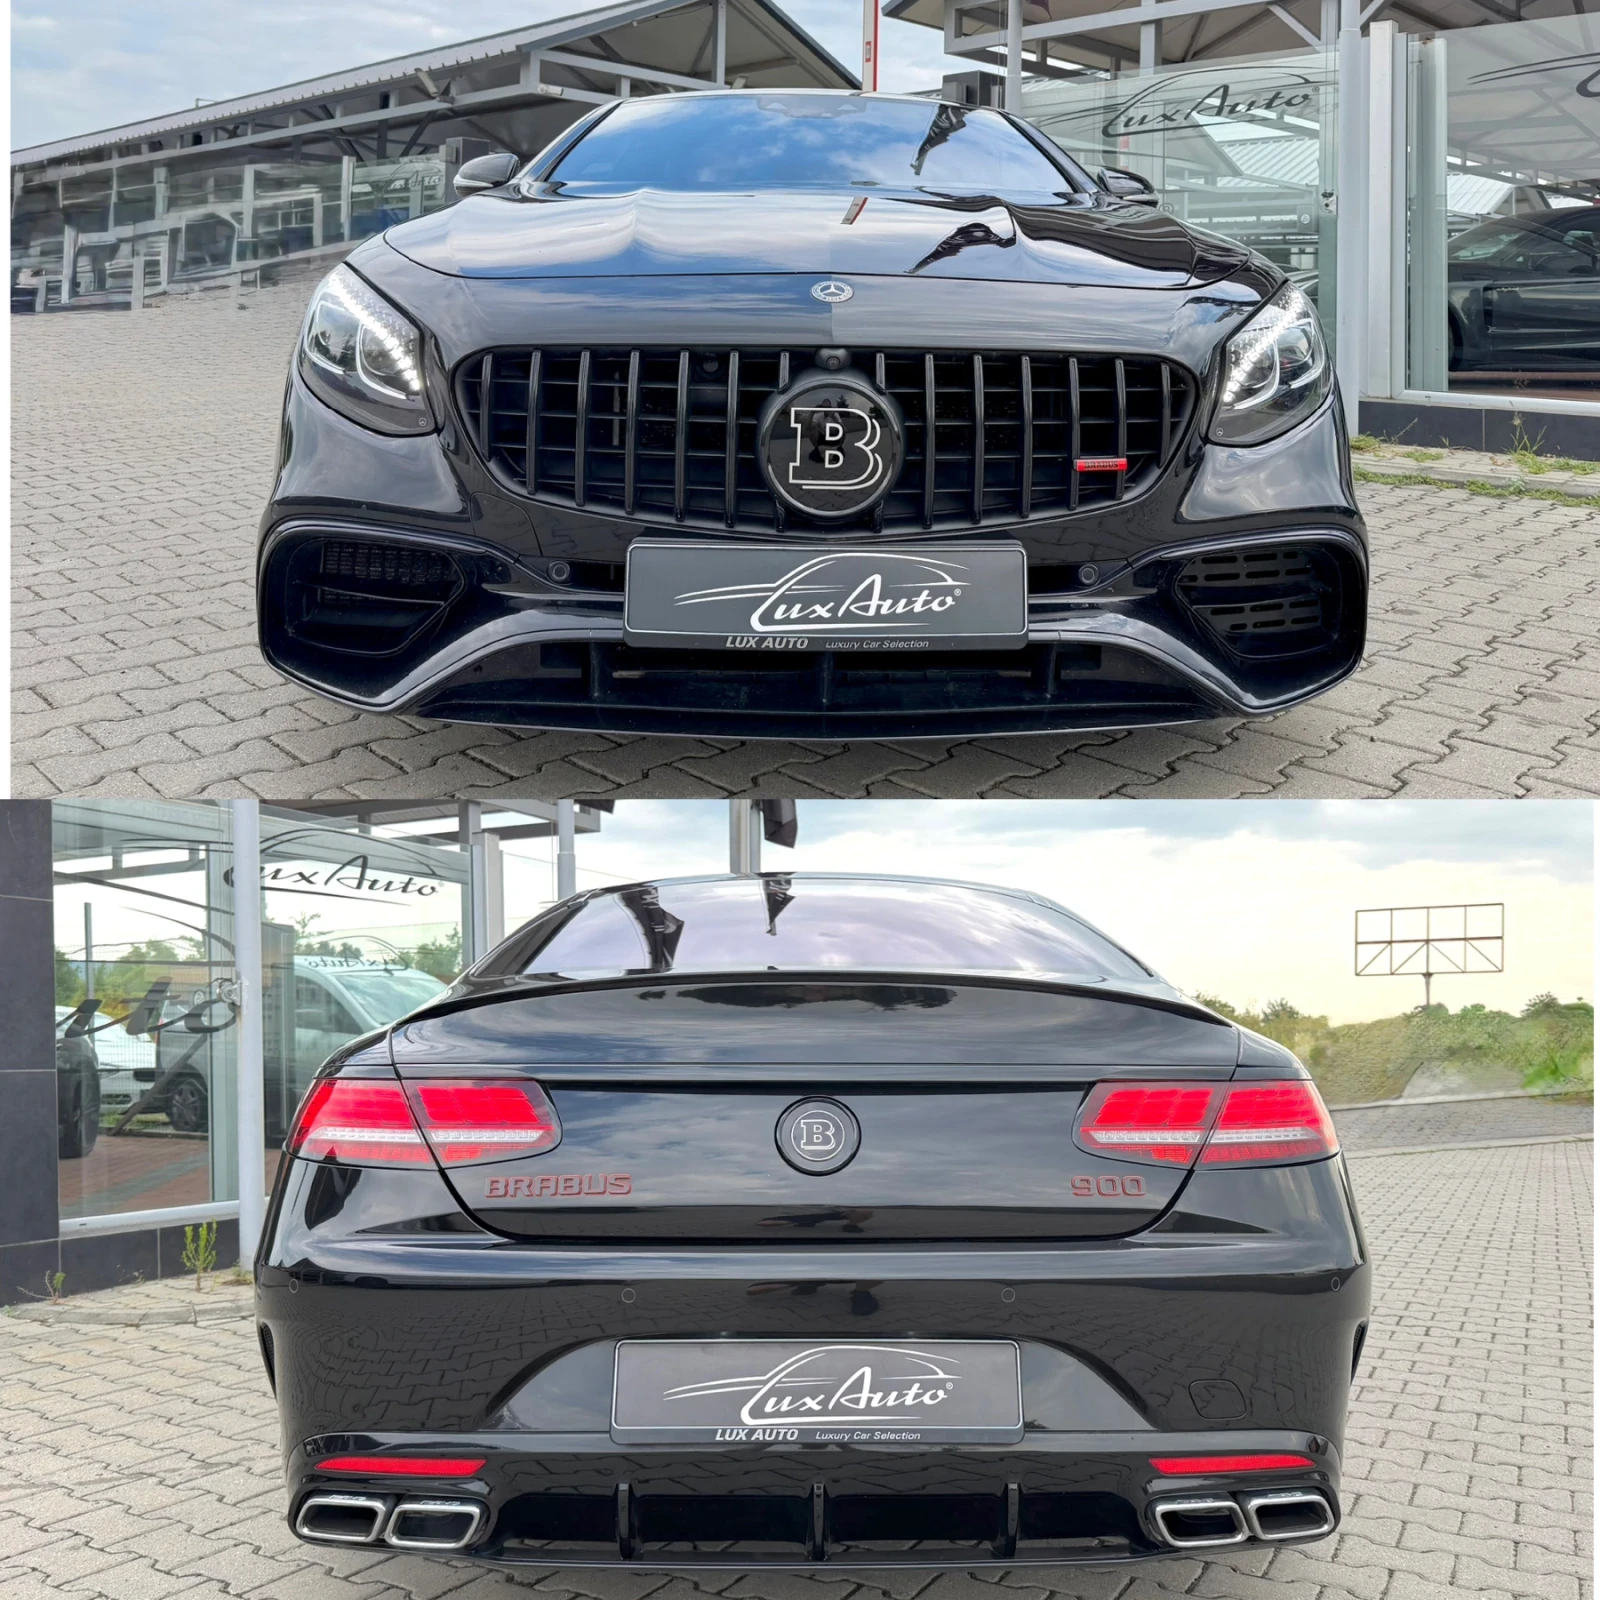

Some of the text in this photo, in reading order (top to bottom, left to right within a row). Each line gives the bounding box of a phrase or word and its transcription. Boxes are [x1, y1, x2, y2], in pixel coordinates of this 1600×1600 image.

[725, 636, 929, 650] LUX AUTO Luxury Car Selection
[485, 1174, 632, 1198] BRABUS
[1071, 1175, 1147, 1196] 900
[715, 1429, 921, 1441] LUX AUTO Luxury Car Selection
